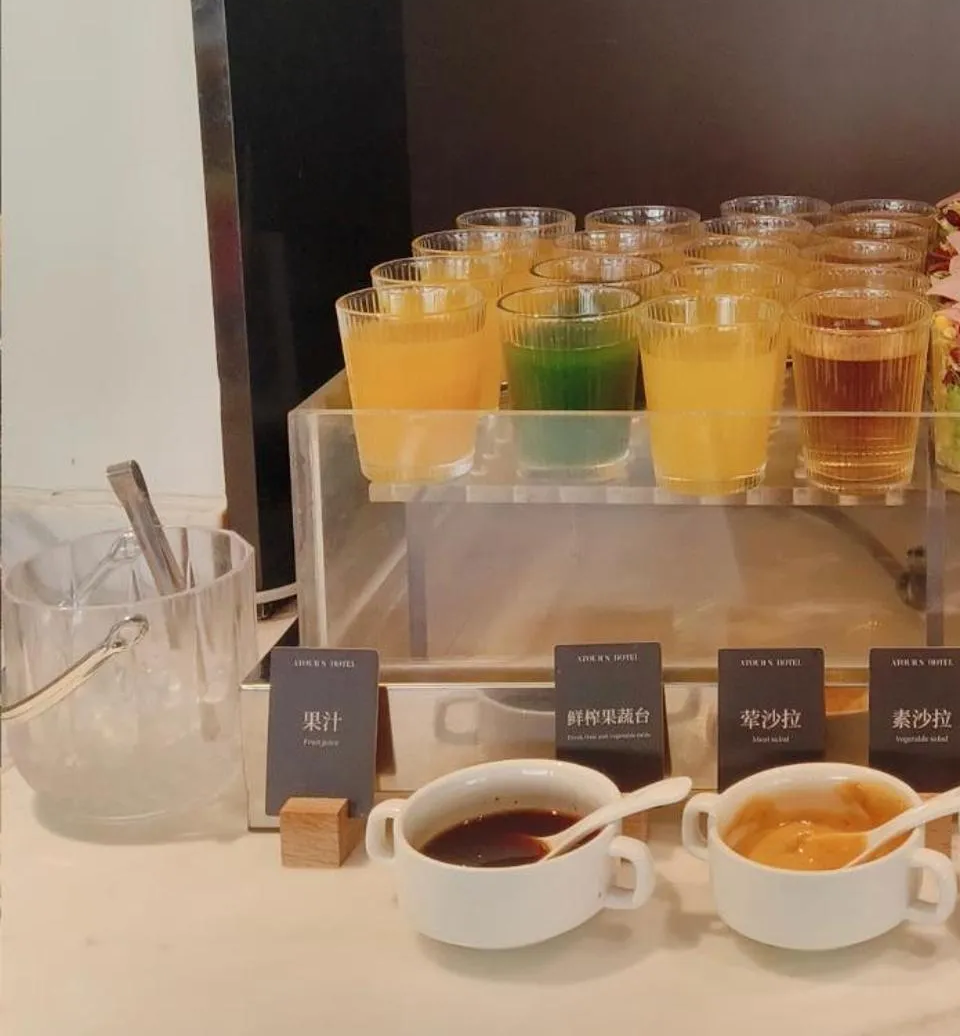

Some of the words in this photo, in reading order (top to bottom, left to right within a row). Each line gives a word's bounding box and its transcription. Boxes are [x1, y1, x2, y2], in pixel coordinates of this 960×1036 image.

[302, 711, 343, 732] 果汁
[567, 707, 650, 726] 鲜榨果蔬台
[740, 708, 802, 729] 荤沙拉
[892, 708, 952, 729] 素沙拉
